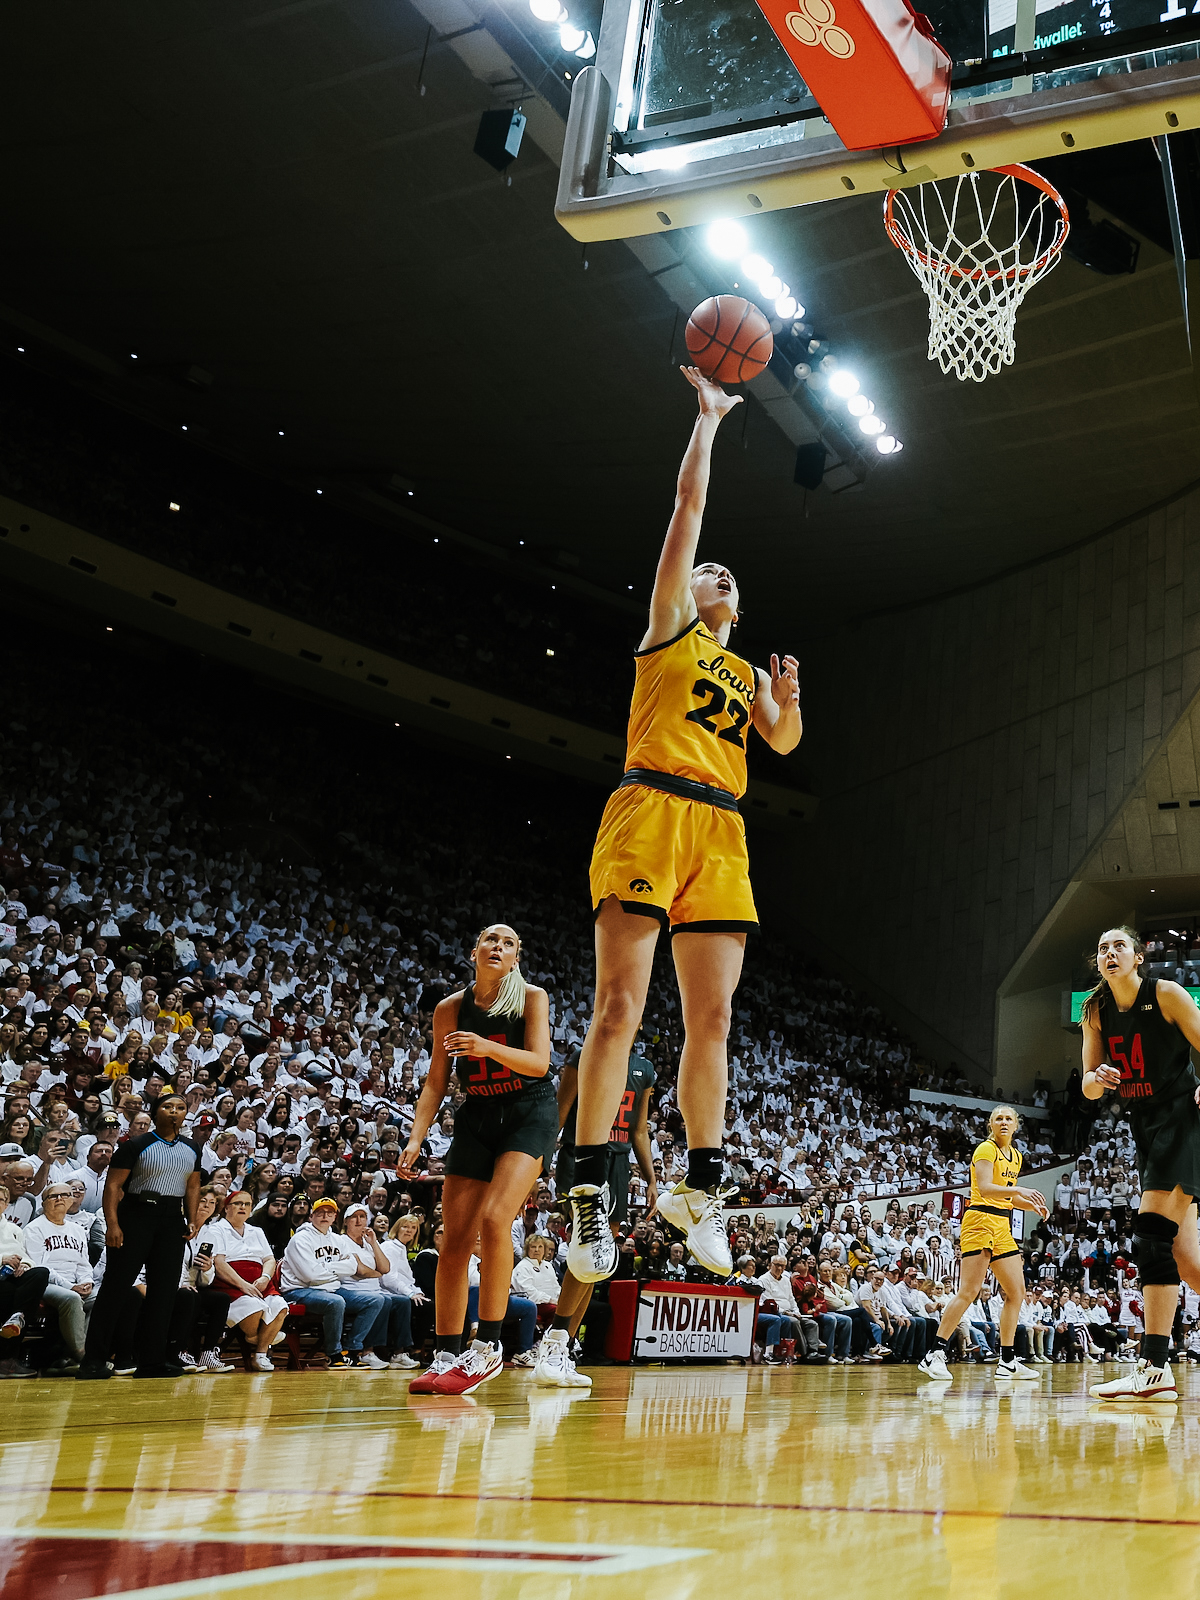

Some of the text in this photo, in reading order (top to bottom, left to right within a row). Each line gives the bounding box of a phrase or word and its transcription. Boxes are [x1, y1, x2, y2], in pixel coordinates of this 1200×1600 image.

[698, 656, 756, 705] Iowa
[685, 678, 748, 750] 22
[1108, 1033, 1144, 1079] 54
[466, 1078, 522, 1096] INDIANA
[652, 1296, 740, 1332] INDIANA
[660, 1334, 728, 1352] BASKETBALL
